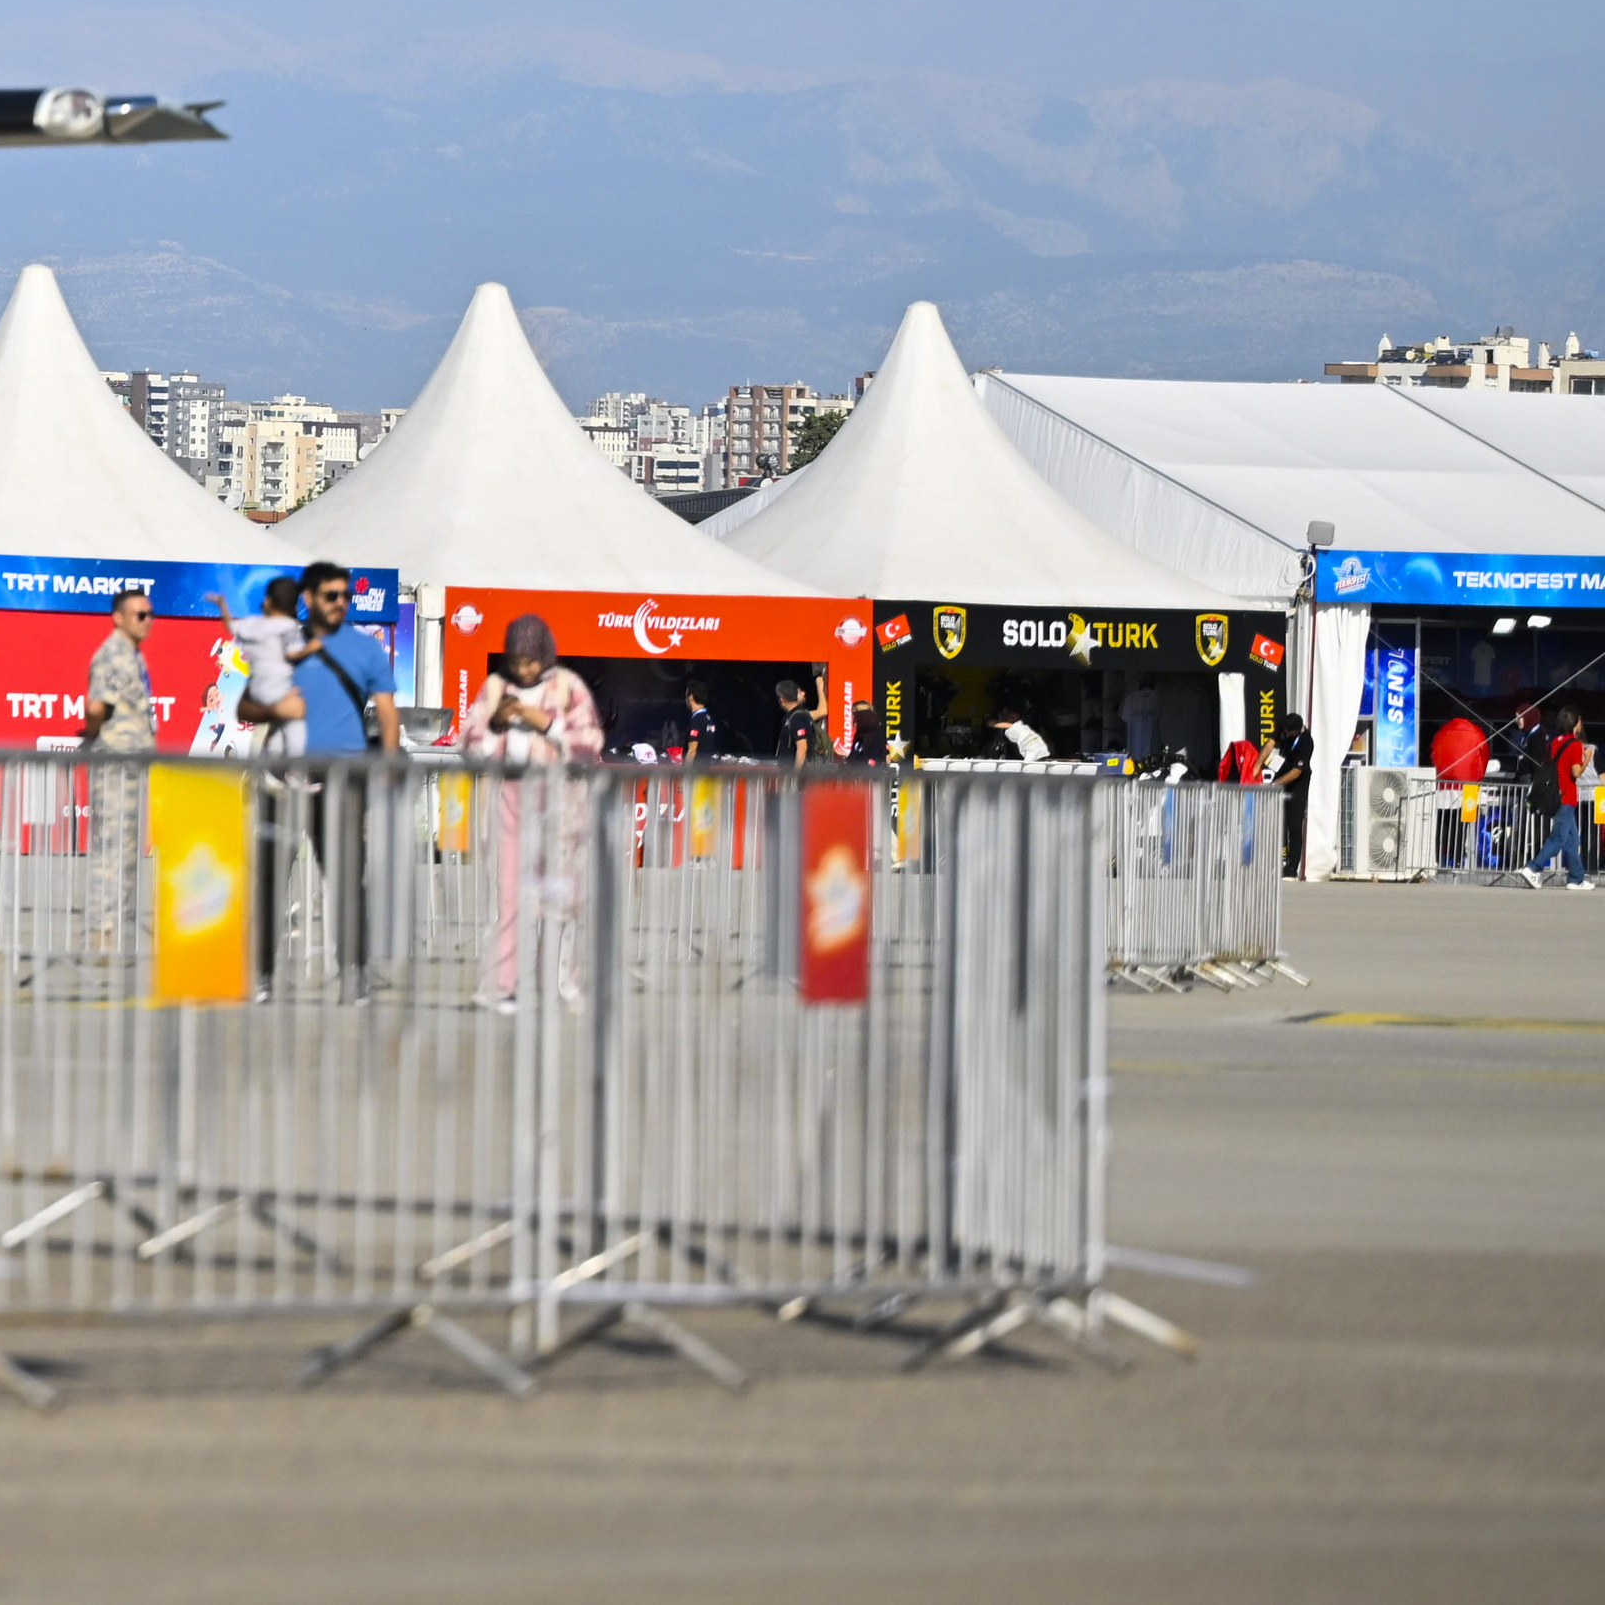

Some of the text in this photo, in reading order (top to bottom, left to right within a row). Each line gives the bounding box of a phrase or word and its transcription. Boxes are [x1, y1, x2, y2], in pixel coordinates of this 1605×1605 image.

[2, 572, 156, 596] TRT MARKET
[1452, 570, 1577, 590] TEKNOFEST
[597, 611, 721, 631] TÜRK YILDIZLARI
[1002, 619, 1067, 647] SOLO
[6, 692, 58, 719] TRT
